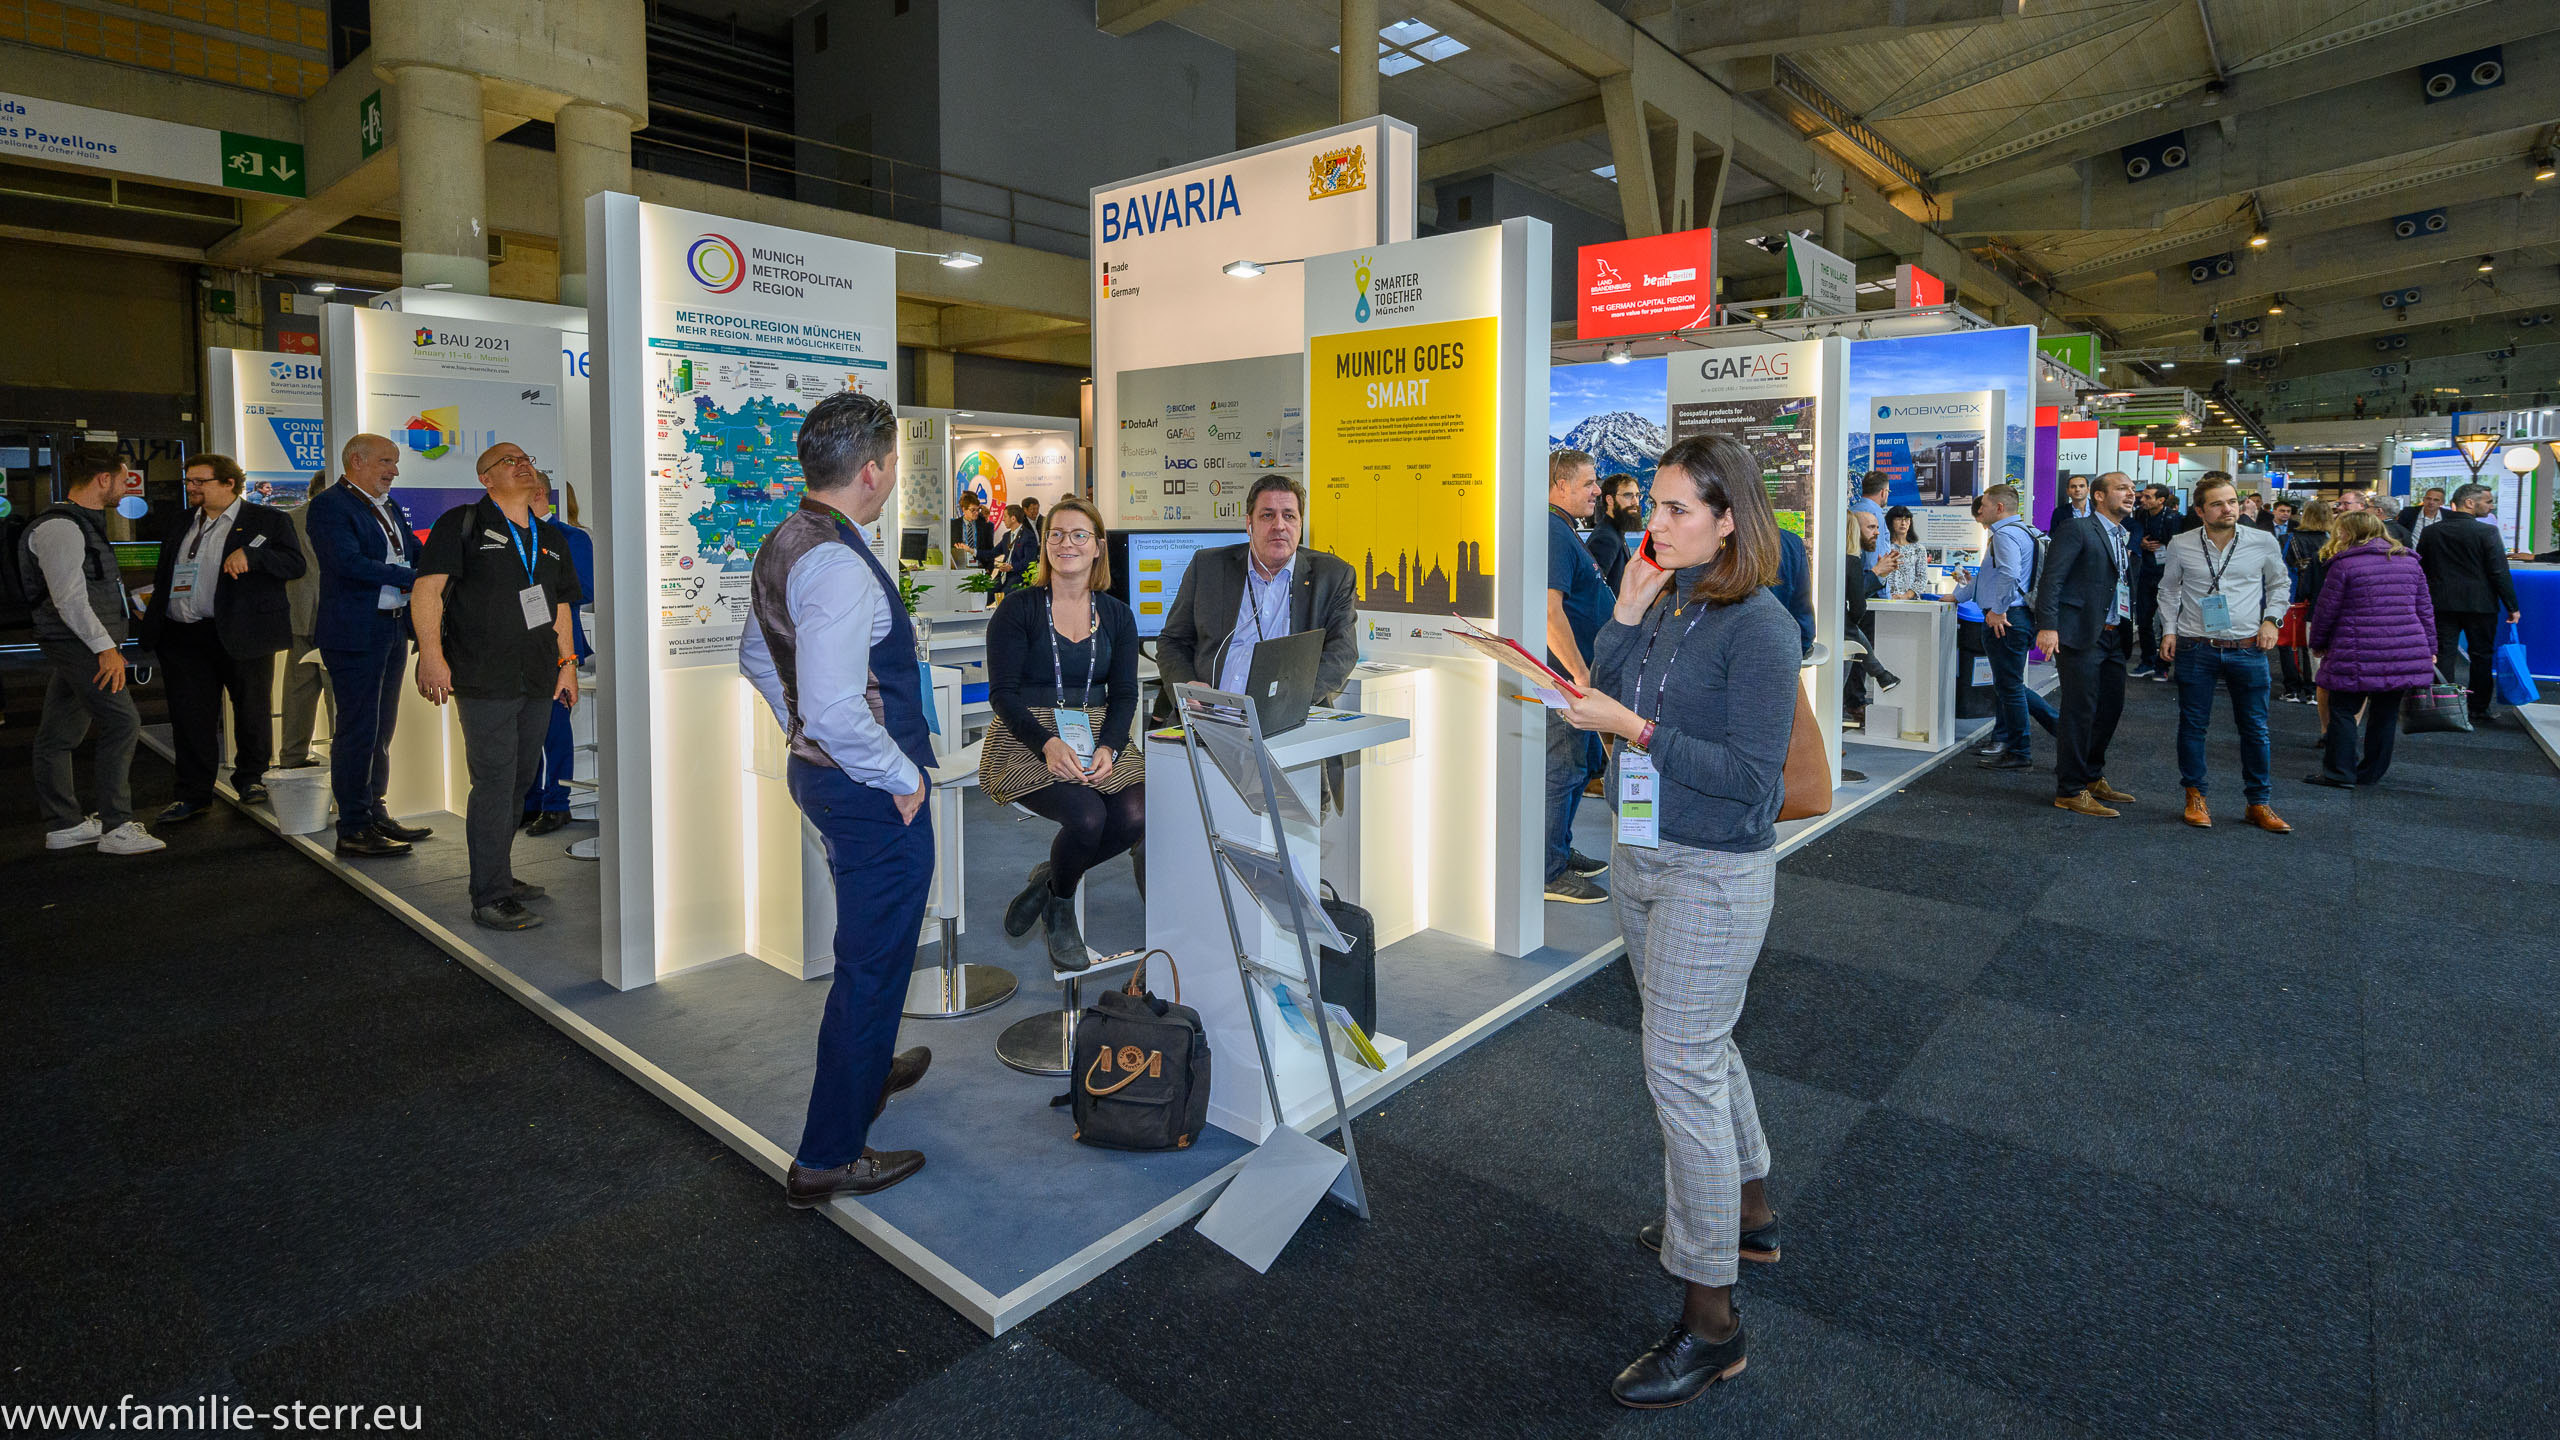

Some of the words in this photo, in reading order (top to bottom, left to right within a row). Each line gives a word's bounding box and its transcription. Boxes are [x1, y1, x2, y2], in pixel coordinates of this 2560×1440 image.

[25, 127, 118, 154] Pavellons
[48, 145, 74, 156] Other
[76, 151, 100, 160] Halls
[1102, 174, 1242, 243] BAVARIA
[752, 248, 804, 266] MUNICH
[1110, 262, 1129, 273] made
[752, 264, 853, 290] METROPOLITAN
[1110, 276, 1117, 285] in
[1374, 272, 1419, 292] SMARTER
[752, 281, 804, 298] REGION
[1111, 285, 1140, 298] Germany
[1591, 283, 1631, 292] BRANDENBURG
[1374, 288, 1423, 306] TOGETHER
[1606, 302, 1636, 311] GERMAN
[1637, 298, 1666, 308] CAPITAL
[1667, 294, 1696, 304] REGION
[1375, 304, 1415, 316] München
[1664, 304, 1695, 312] investment
[676, 310, 799, 334] METROPOLREGION
[803, 324, 861, 342] MÜNCHEN
[440, 333, 469, 347] BAU
[474, 336, 509, 351] 2021
[676, 326, 707, 336] MEHR
[710, 328, 752, 341] REGION.
[756, 334, 784, 345] MEHR
[786, 336, 864, 353] MÖGLICHKEITEN.
[413, 348, 446, 359] January
[480, 353, 509, 363] Munich
[1336, 348, 1406, 379] MUNICH
[1414, 342, 1464, 372] GOES
[1366, 379, 1430, 409] SMART
[1172, 404, 1196, 412] BICCnet
[1679, 410, 1708, 418] Geospatial
[1709, 409, 1734, 417] products
[1894, 404, 1980, 416] MOBIWORX
[1128, 418, 1158, 429] DataArt
[1679, 417, 1710, 426] sustainable
[1217, 431, 1241, 440] emz
[1204, 458, 1225, 469] GBCI
[1227, 461, 1247, 469] Europe
